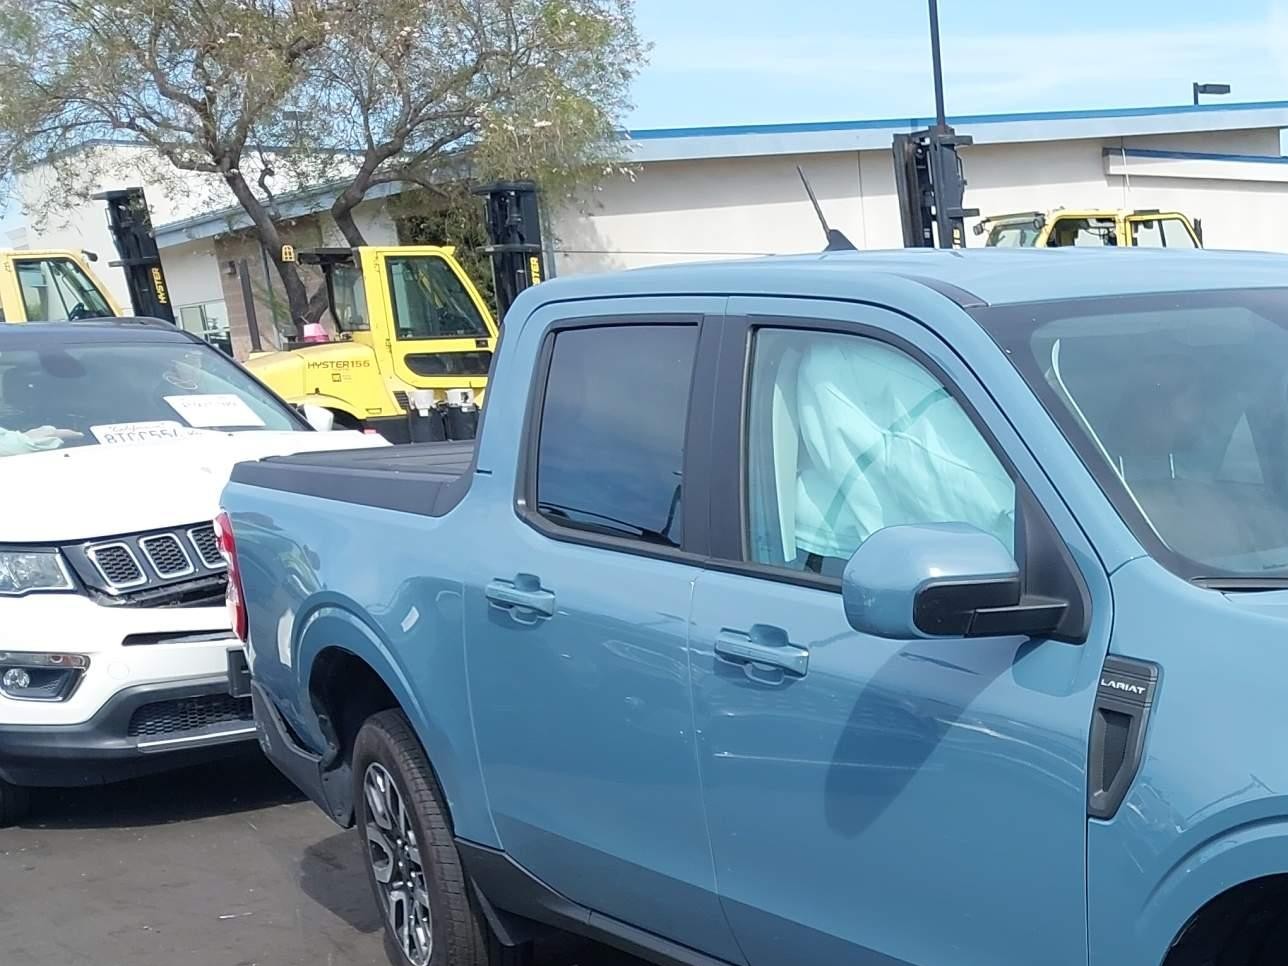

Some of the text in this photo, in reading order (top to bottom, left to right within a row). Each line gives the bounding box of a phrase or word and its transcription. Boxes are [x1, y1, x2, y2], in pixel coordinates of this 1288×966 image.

[151, 267, 167, 304] HYSTER
[307, 361, 349, 369] HYSTER
[1100, 678, 1146, 695] LARIAT
